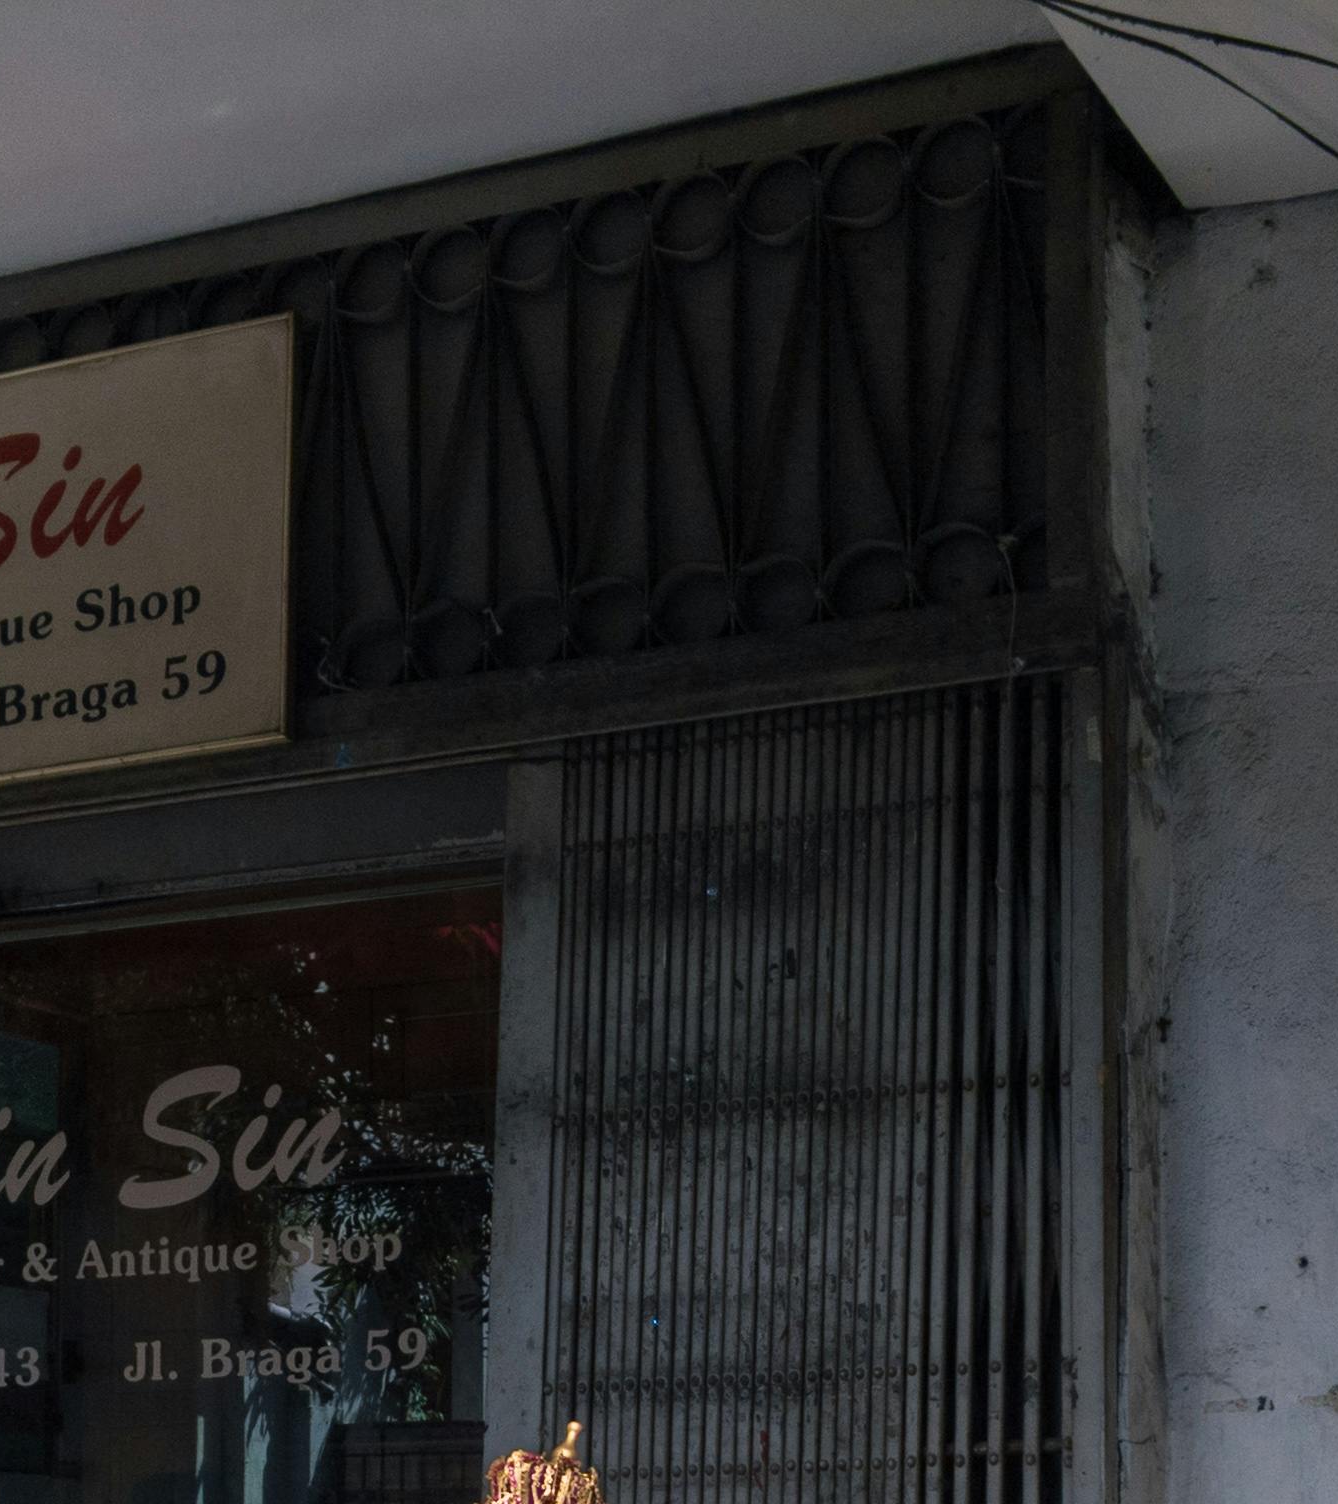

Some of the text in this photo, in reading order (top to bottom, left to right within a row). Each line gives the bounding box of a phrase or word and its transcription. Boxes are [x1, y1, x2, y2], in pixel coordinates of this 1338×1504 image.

[74, 583, 202, 634] Shop
[161, 648, 227, 700] 59
[118, 1064, 346, 1210] Sin
[21, 1242, 59, 1282] &
[75, 1236, 258, 1284] Antique
[278, 1226, 403, 1272] Shop
[200, 1335, 343, 1384] Braga
[364, 1327, 428, 1370] 59
